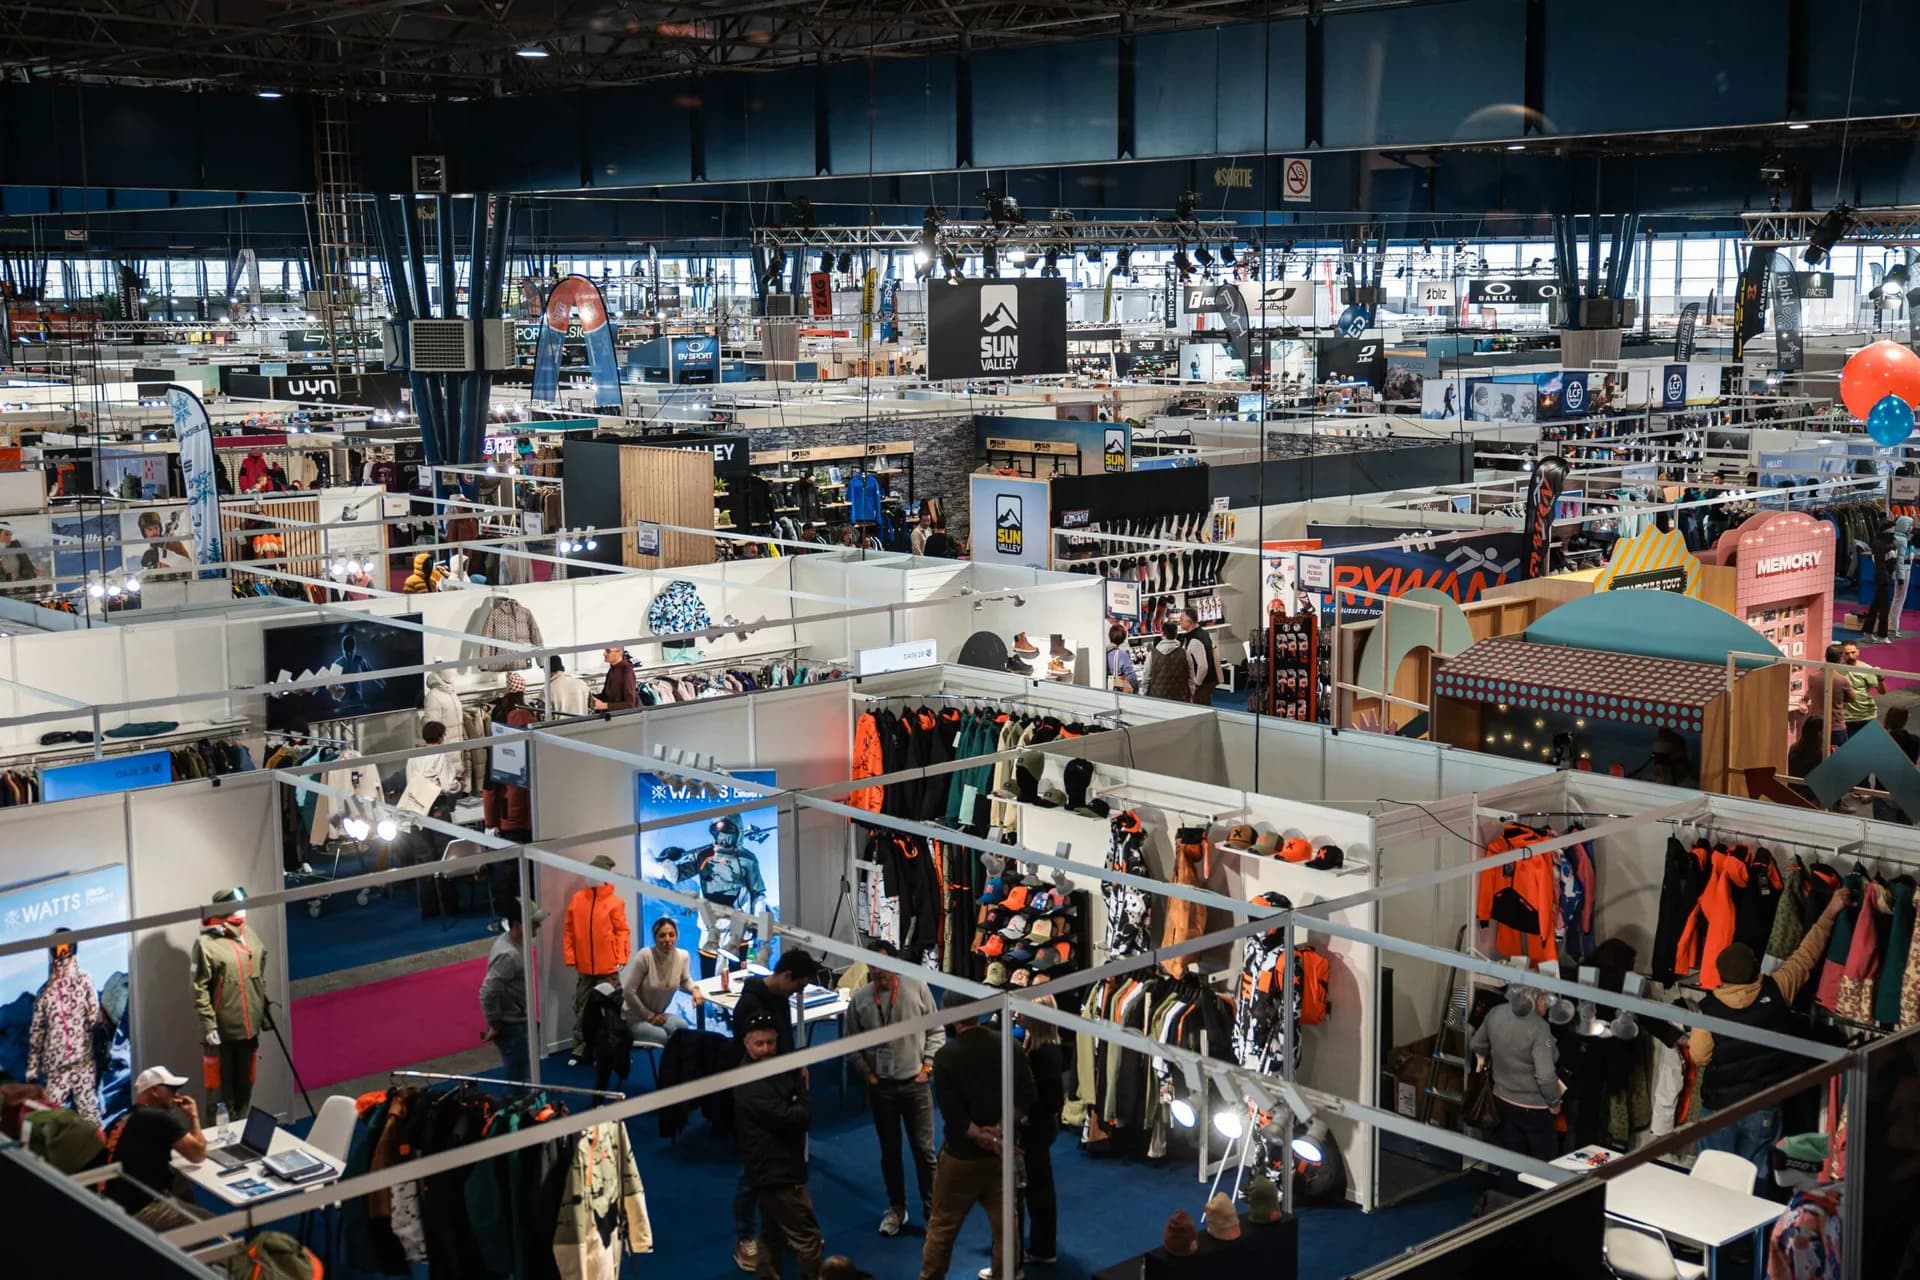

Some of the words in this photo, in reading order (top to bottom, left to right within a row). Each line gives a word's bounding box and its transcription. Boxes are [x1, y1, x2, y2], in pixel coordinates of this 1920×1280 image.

[1220, 168, 1253, 188] SORTIE
[815, 279, 826, 308] ZAG
[1805, 287, 1828, 297] RACER
[980, 335, 1018, 358] SUN
[980, 358, 1018, 371] VALLEY
[1568, 388, 1581, 398] LCF
[1105, 453, 1125, 465] SUN
[998, 528, 1021, 544] SUN
[998, 543, 1022, 554] VALLEY
[1756, 550, 1823, 577] MEMORY
[1662, 576, 1682, 590] TOUT
[21, 893, 80, 924] WATTS
